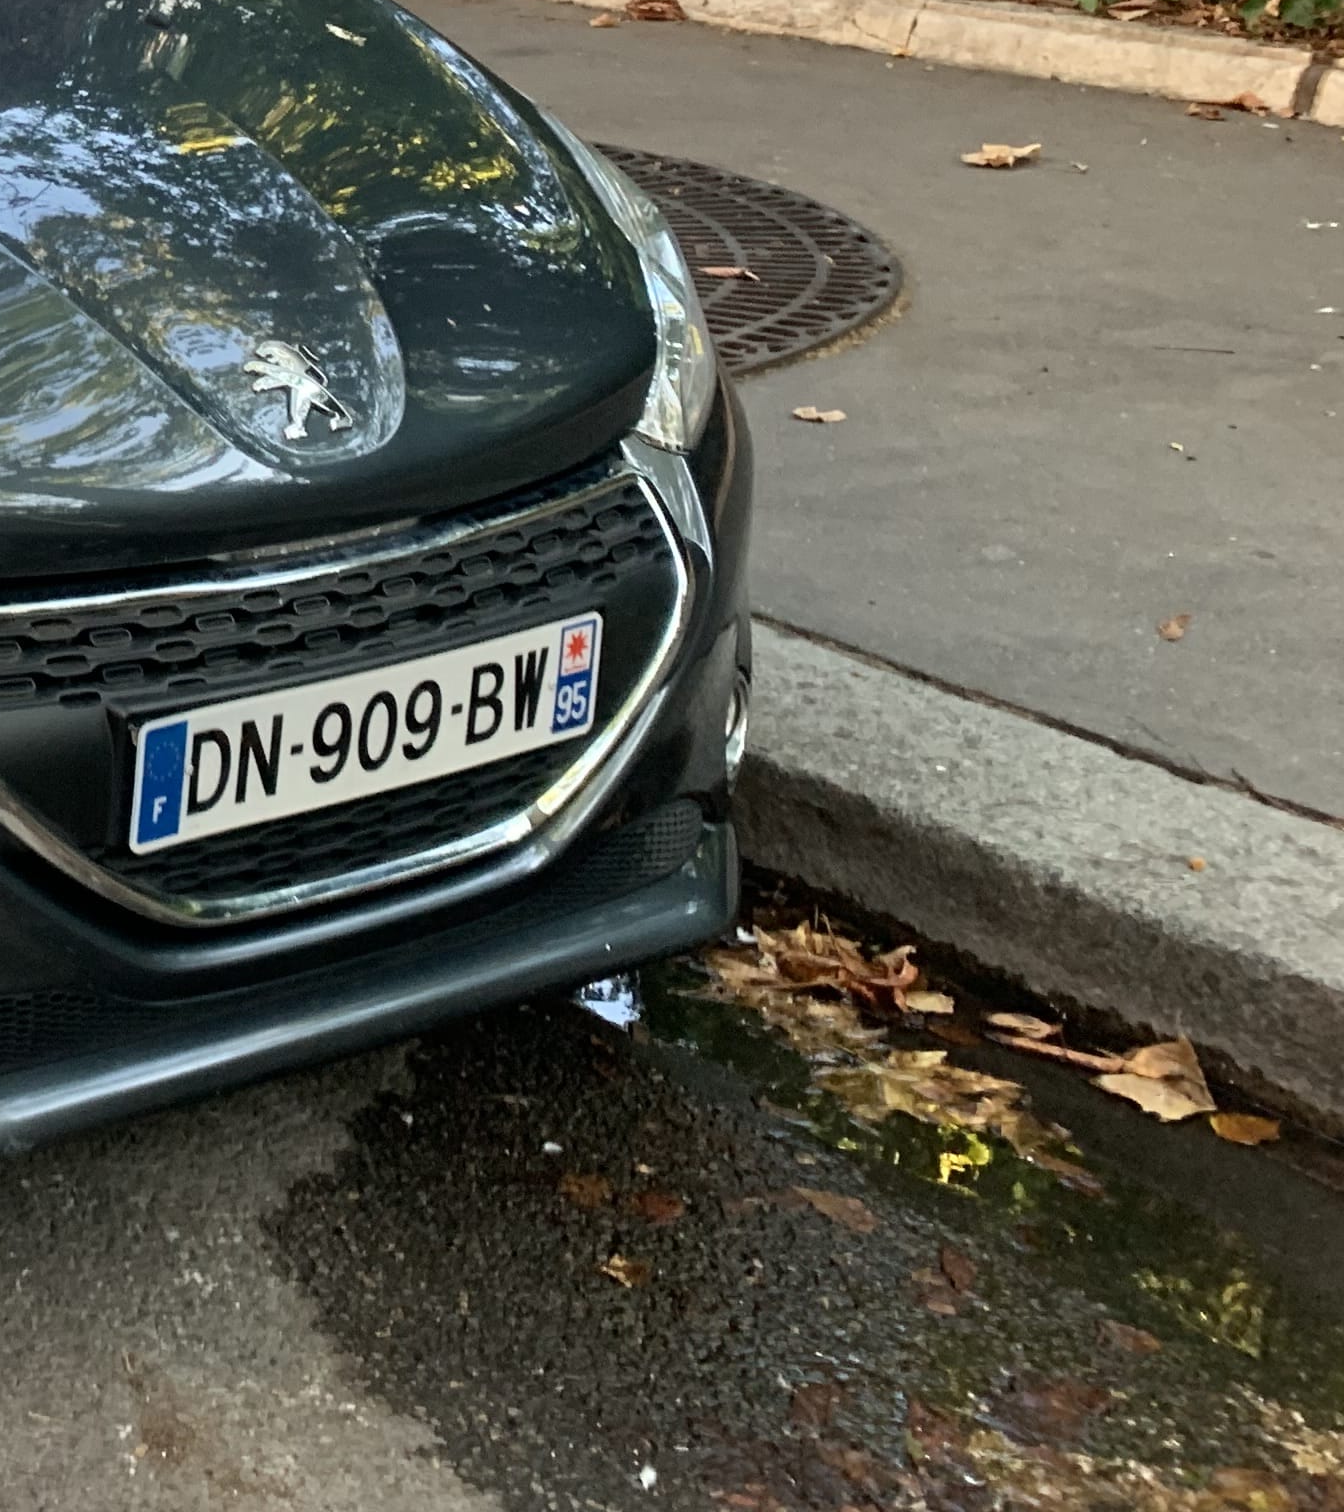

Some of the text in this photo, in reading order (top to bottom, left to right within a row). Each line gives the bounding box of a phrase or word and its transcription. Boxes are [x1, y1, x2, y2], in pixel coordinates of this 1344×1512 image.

[555, 680, 588, 724] 95
[187, 646, 550, 816] DN-909-BW
[151, 795, 168, 825] F
